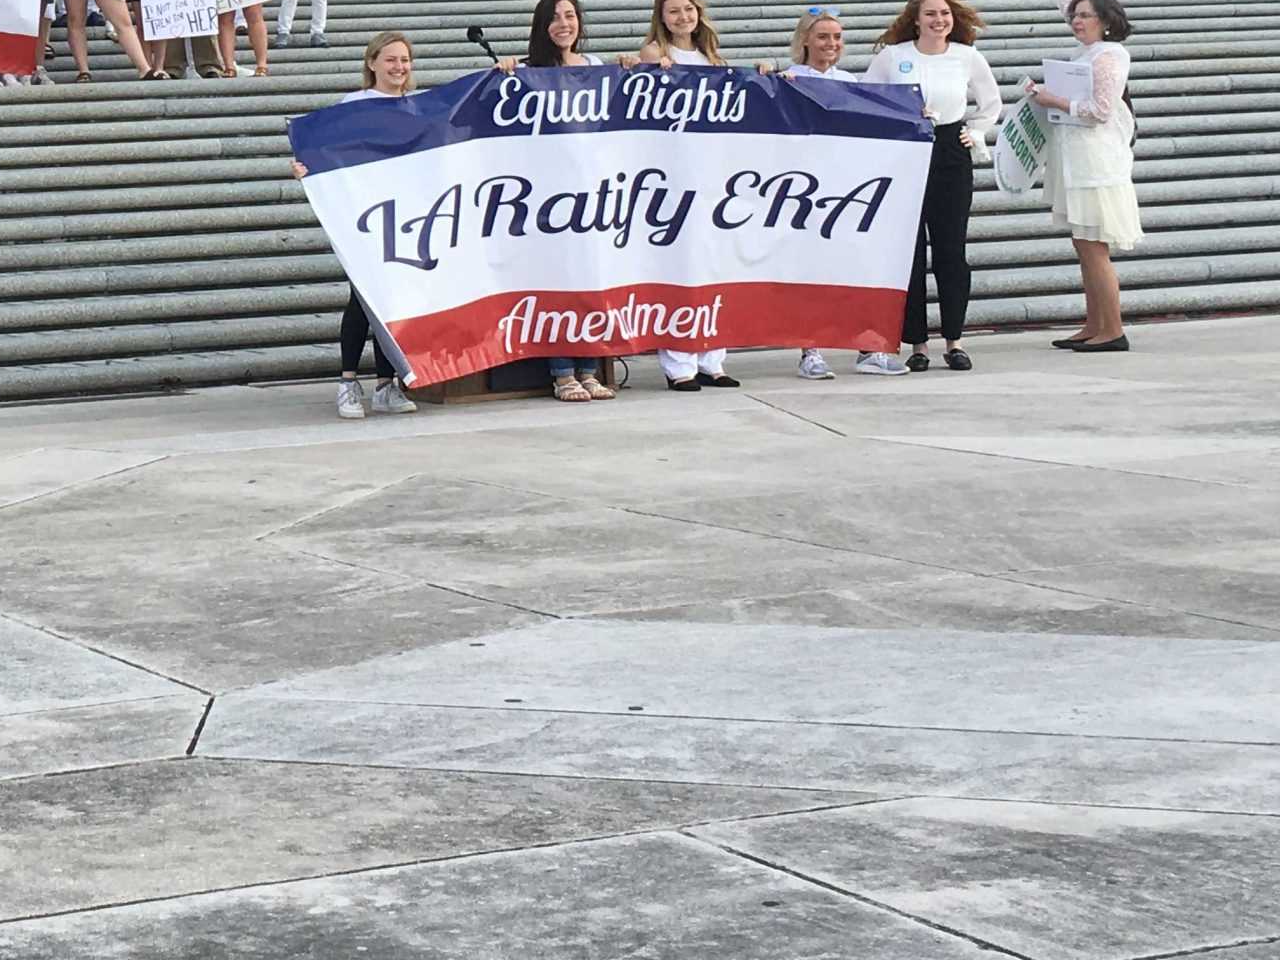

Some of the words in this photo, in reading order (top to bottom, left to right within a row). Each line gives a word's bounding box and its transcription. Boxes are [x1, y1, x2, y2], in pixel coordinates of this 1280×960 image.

[187, 6, 218, 33] HER
[493, 75, 610, 136] Equal
[621, 72, 747, 132] Rights
[1017, 101, 1047, 154] FEMINIST
[1002, 117, 1039, 177] MAJORITY
[356, 184, 462, 271] LA
[474, 168, 697, 249] Ratify
[712, 170, 893, 240] ERA
[498, 293, 723, 353] Amendment
